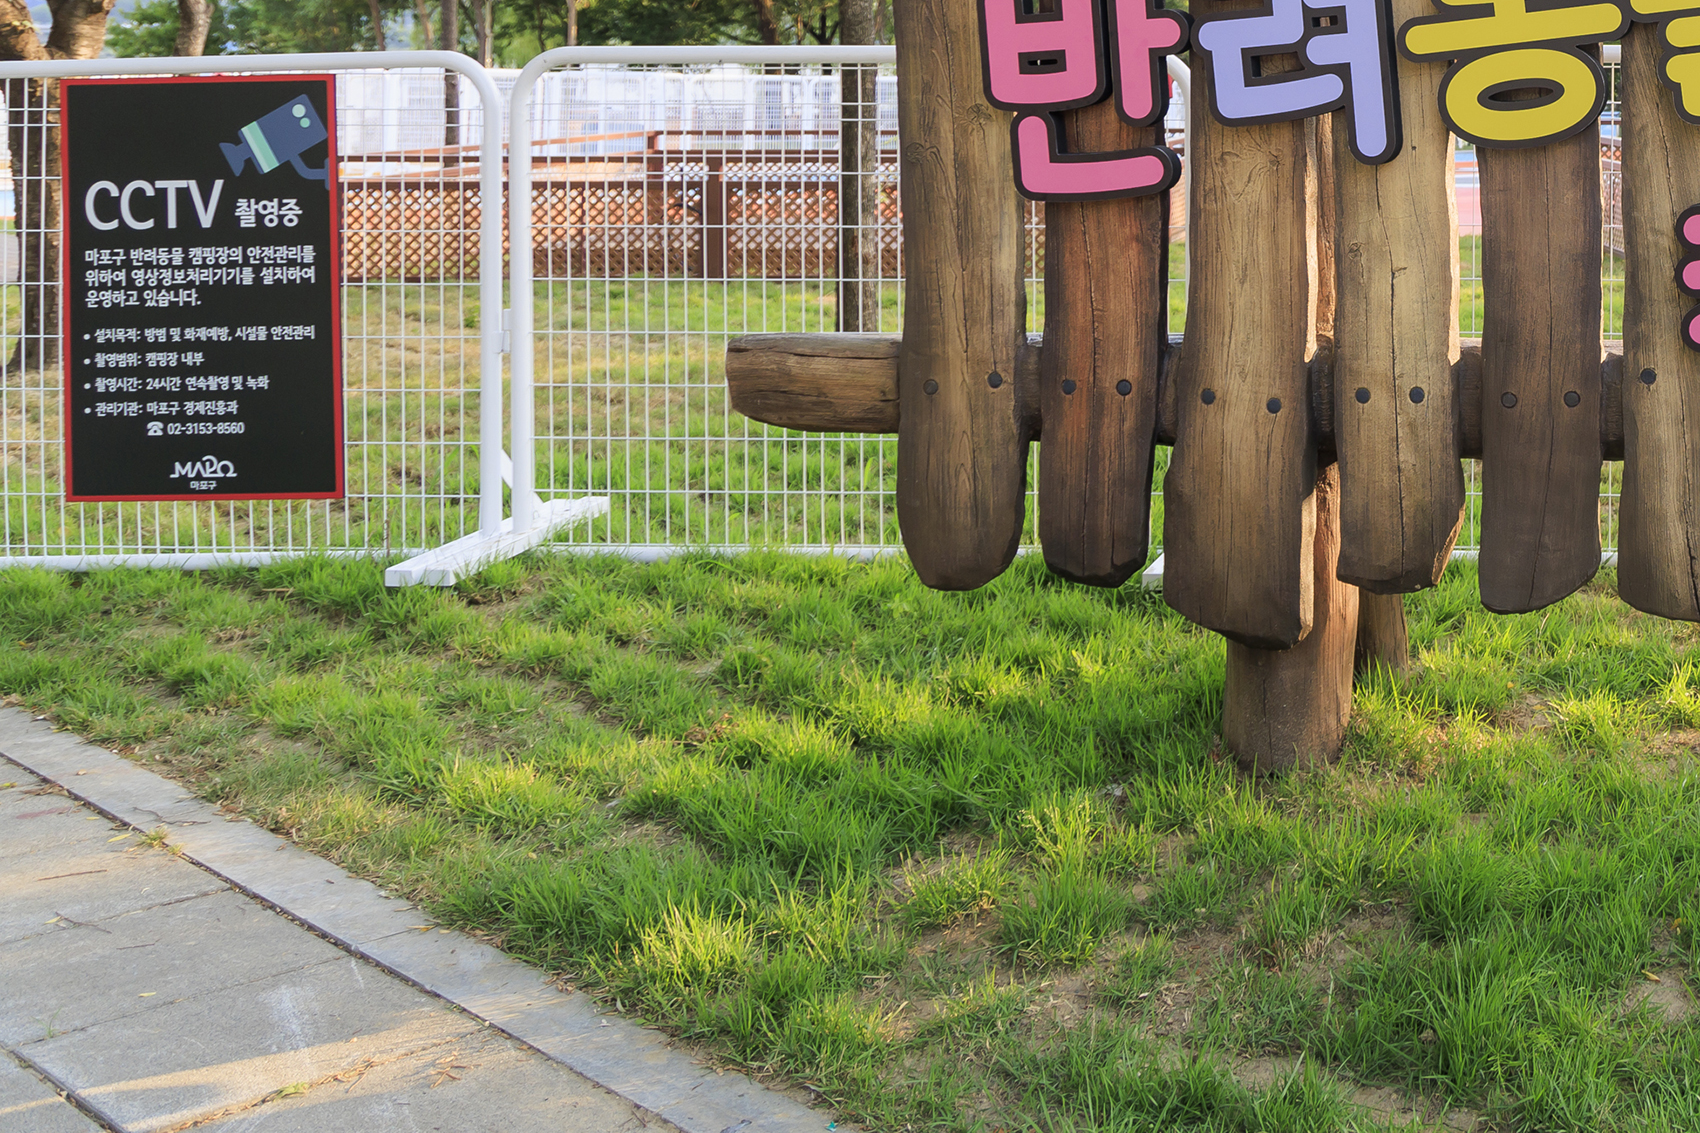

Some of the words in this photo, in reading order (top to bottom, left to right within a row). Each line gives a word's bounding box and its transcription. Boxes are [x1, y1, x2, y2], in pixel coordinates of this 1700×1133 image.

[85, 179, 224, 230] CCTV
[235, 198, 303, 227] 촬영중
[85, 249, 126, 265] 마포구
[130, 247, 185, 264] 반려동물
[188, 247, 243, 264] 캠핑장의
[247, 245, 316, 264] 안전관리를
[85, 270, 126, 286] 위하여
[131, 268, 255, 286] 영상정보처리기기를
[260, 266, 316, 285] 설치하여
[85, 290, 139, 307] 운영하고
[143, 289, 201, 307] 있습니다.
[94, 328, 141, 343] 설치목적:
[145, 328, 167, 342] 방범
[170, 328, 181, 342] 및
[184, 326, 232, 342] 화재예방,
[236, 326, 267, 341] 시설물
[271, 325, 315, 340] 안전관리
[95, 353, 142, 367] 촬영범위:
[146, 352, 178, 367] 캠핑장
[182, 352, 204, 366] 내부
[95, 377, 142, 392] 촬영시간:
[146, 377, 181, 391] 24시간
[186, 376, 229, 390] 연속촬영
[232, 376, 243, 390] 및
[246, 375, 269, 390] 녹화
[95, 402, 143, 417] 관리기관:
[147, 401, 180, 415] 마포구
[183, 400, 239, 416] 경제진흥과
[167, 422, 245, 435] 02-3153-8560
[190, 481, 217, 490] 마포구
